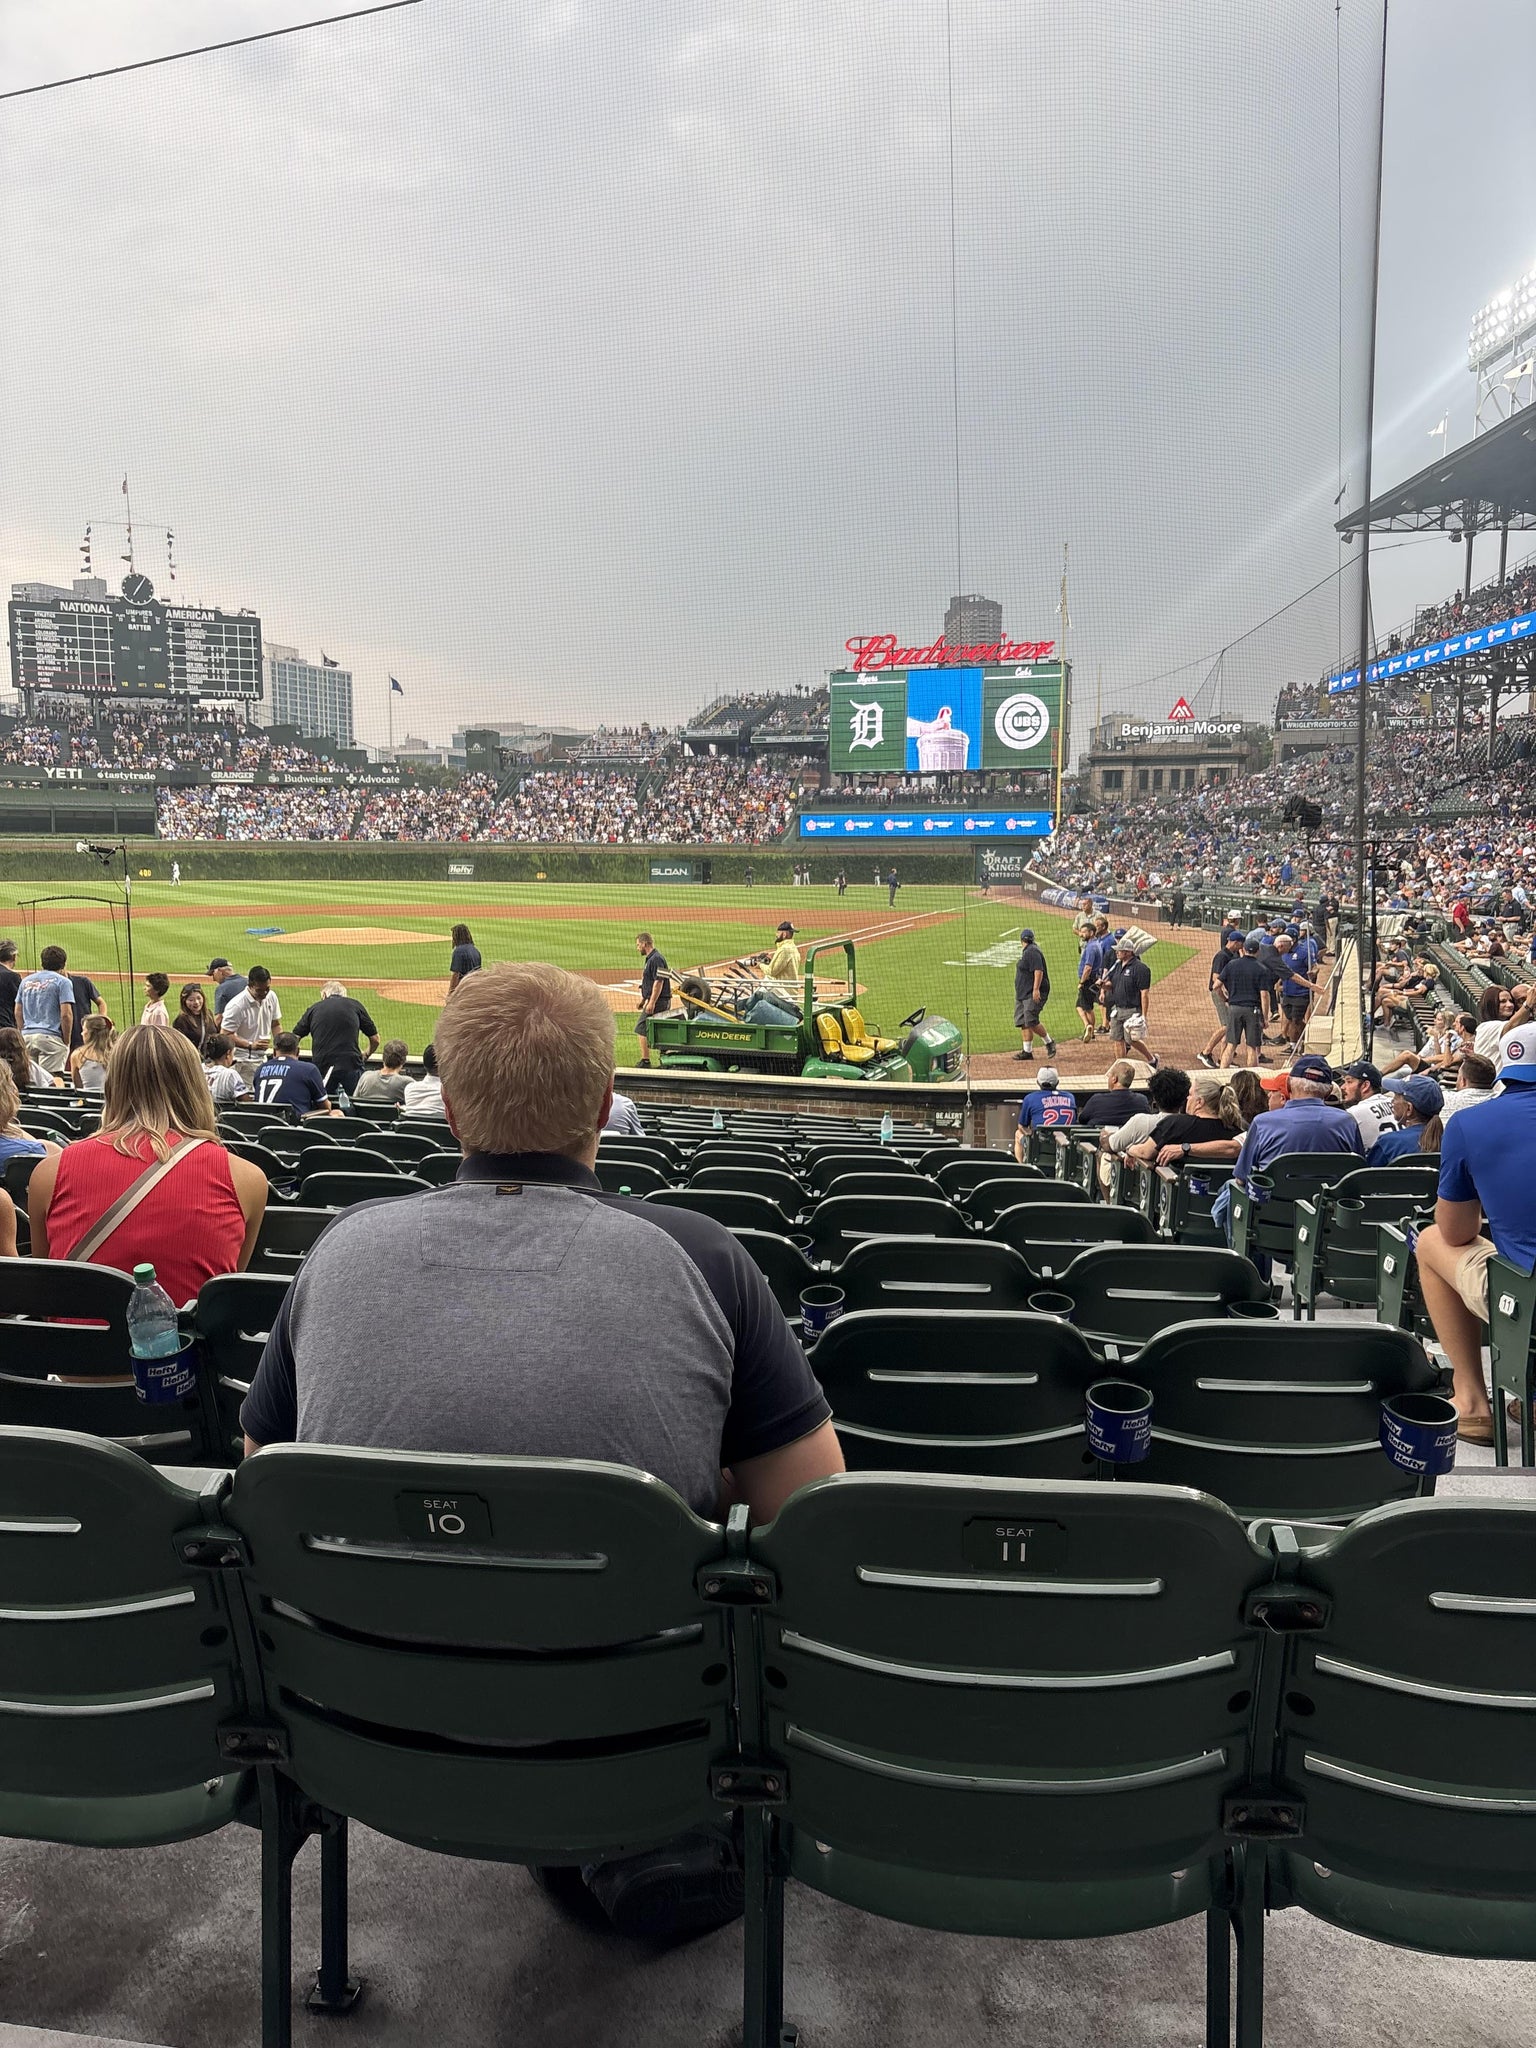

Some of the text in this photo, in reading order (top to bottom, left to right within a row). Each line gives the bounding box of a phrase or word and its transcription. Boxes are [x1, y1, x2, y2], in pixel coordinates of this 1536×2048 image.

[60, 601, 113, 614] NATIONAL
[165, 609, 215, 621] AMERICAN
[845, 632, 1056, 672] Budweiser
[1014, 666, 1032, 676] Cubs
[1121, 721, 1242, 738] Benjamin Moore
[1286, 720, 1360, 729] WRIGLEYROOFTOPS.CO
[44, 767, 82, 779] YETI
[104, 771, 156, 780] tastytrade
[359, 774, 400, 784] Advocate
[984, 856, 1022, 865] DRAFT
[450, 865, 472, 874] Hefty
[696, 1031, 752, 1041] JOHN DEERE
[260, 1065, 290, 1078] BRYANT
[259, 1079, 283, 1103] 17
[1043, 1109, 1073, 1126] 27
[1503, 1299, 1511, 1311] 11
[827, 1308, 842, 1318] Hefty
[149, 1364, 176, 1376] Hefty
[164, 1371, 188, 1386] Hefty
[1124, 1418, 1147, 1428] Hefty
[1384, 1414, 1400, 1434] Hefty
[1091, 1436, 1113, 1452] Hefty
[1389, 1434, 1412, 1453] Hefty
[1396, 1454, 1424, 1469] Hefty
[424, 1500, 458, 1509] SEAT
[428, 1514, 465, 1534] 10
[996, 1528, 1034, 1537] SEAT
[1003, 1542, 1026, 1561] 11
